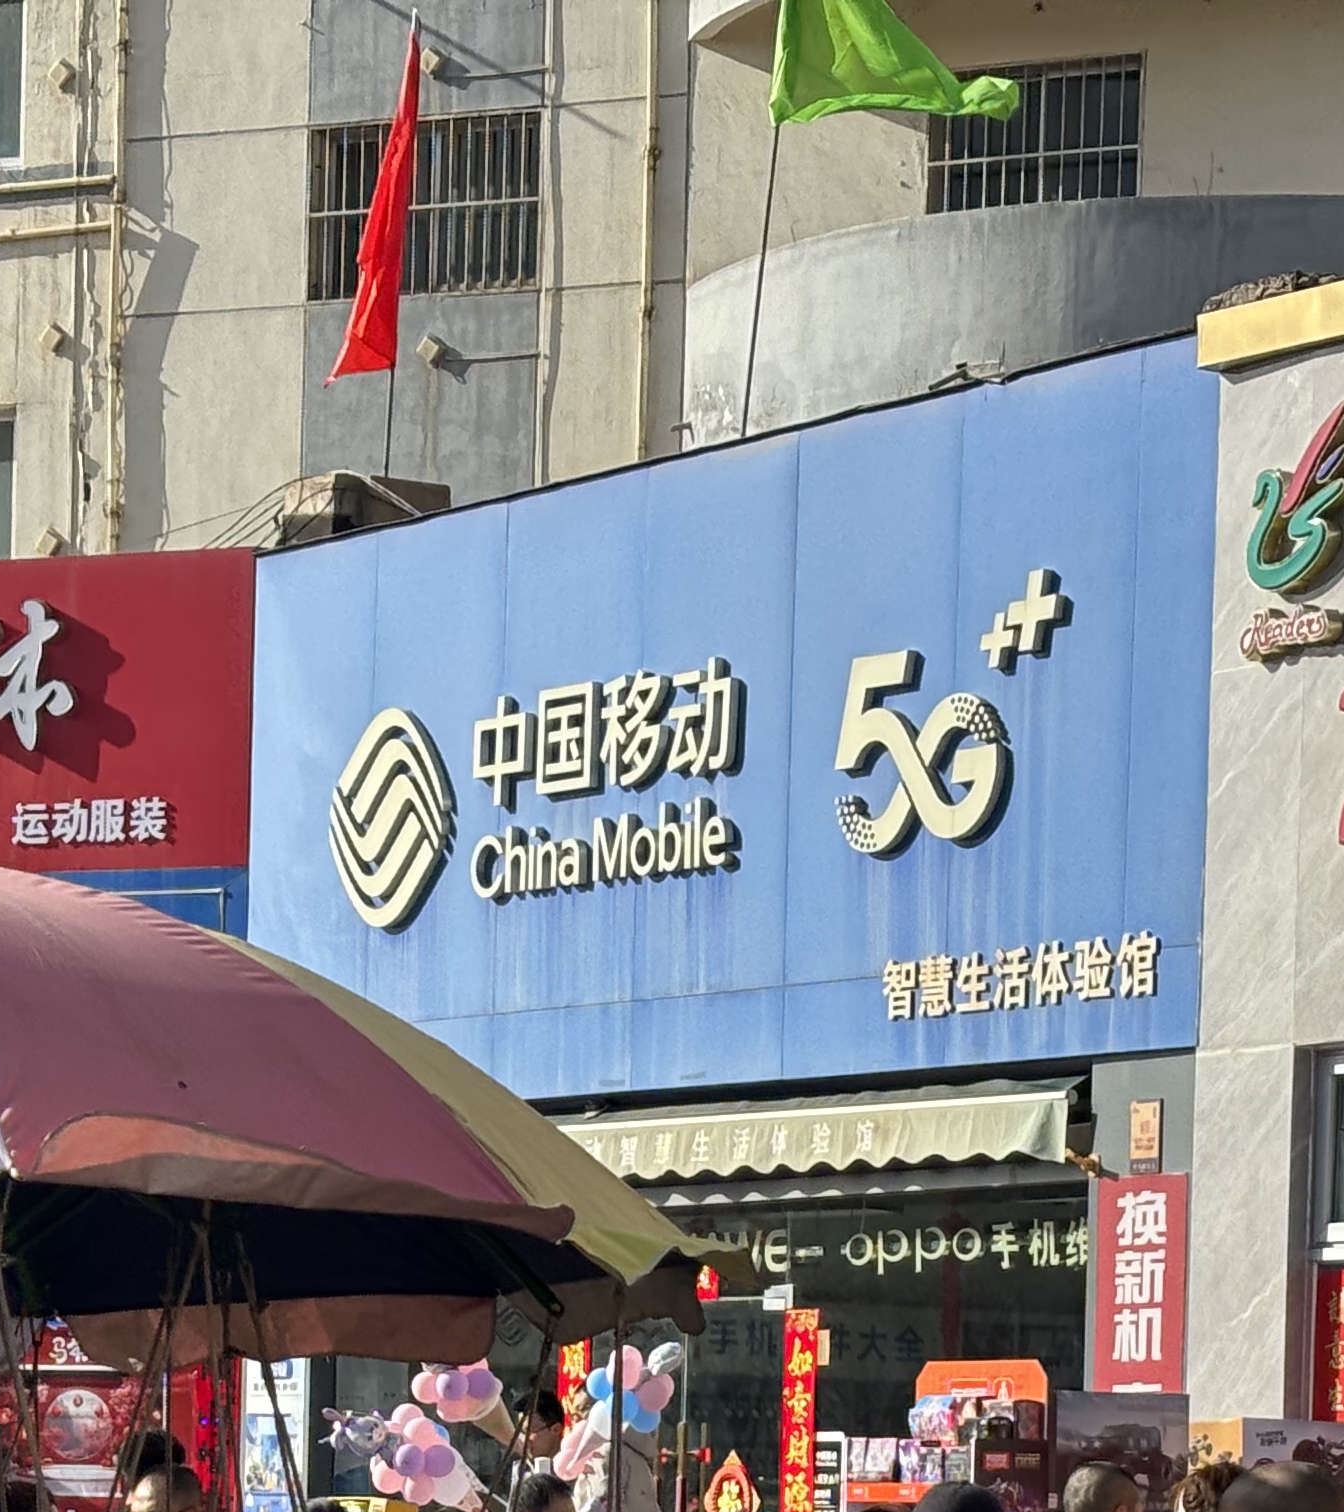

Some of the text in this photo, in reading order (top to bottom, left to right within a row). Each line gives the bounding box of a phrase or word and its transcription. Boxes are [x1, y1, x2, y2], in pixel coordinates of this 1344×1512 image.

[1240, 605, 1329, 658] Readers
[472, 656, 738, 807] 中国移动
[11, 796, 168, 846] 运动服装
[471, 800, 729, 900] China Mobile
[882, 930, 1161, 1022] 智慧生活体验馆
